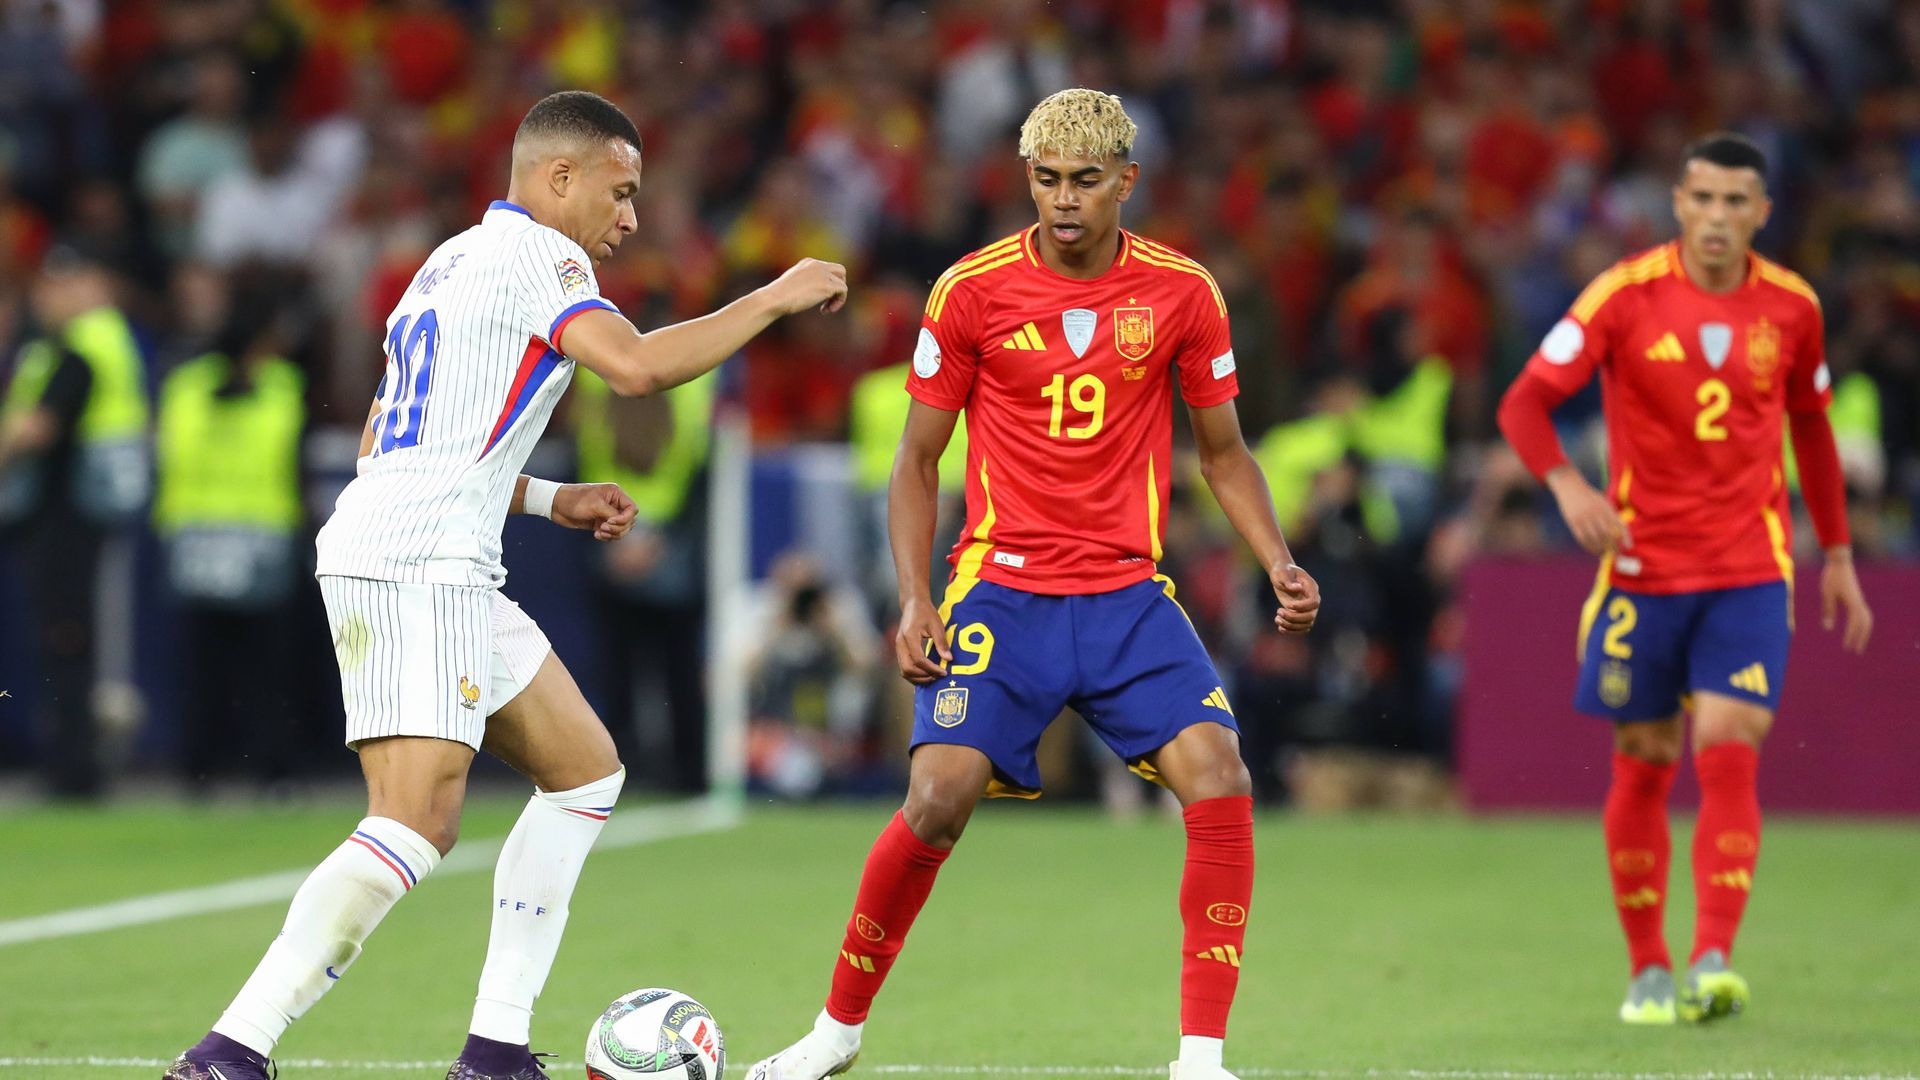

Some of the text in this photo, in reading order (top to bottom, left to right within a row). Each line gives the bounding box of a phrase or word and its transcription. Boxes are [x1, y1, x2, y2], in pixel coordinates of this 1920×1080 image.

[373, 309, 440, 458] 10
[1041, 374, 1106, 439] 19
[1695, 378, 1731, 441] 2
[1604, 596, 1637, 659] 2
